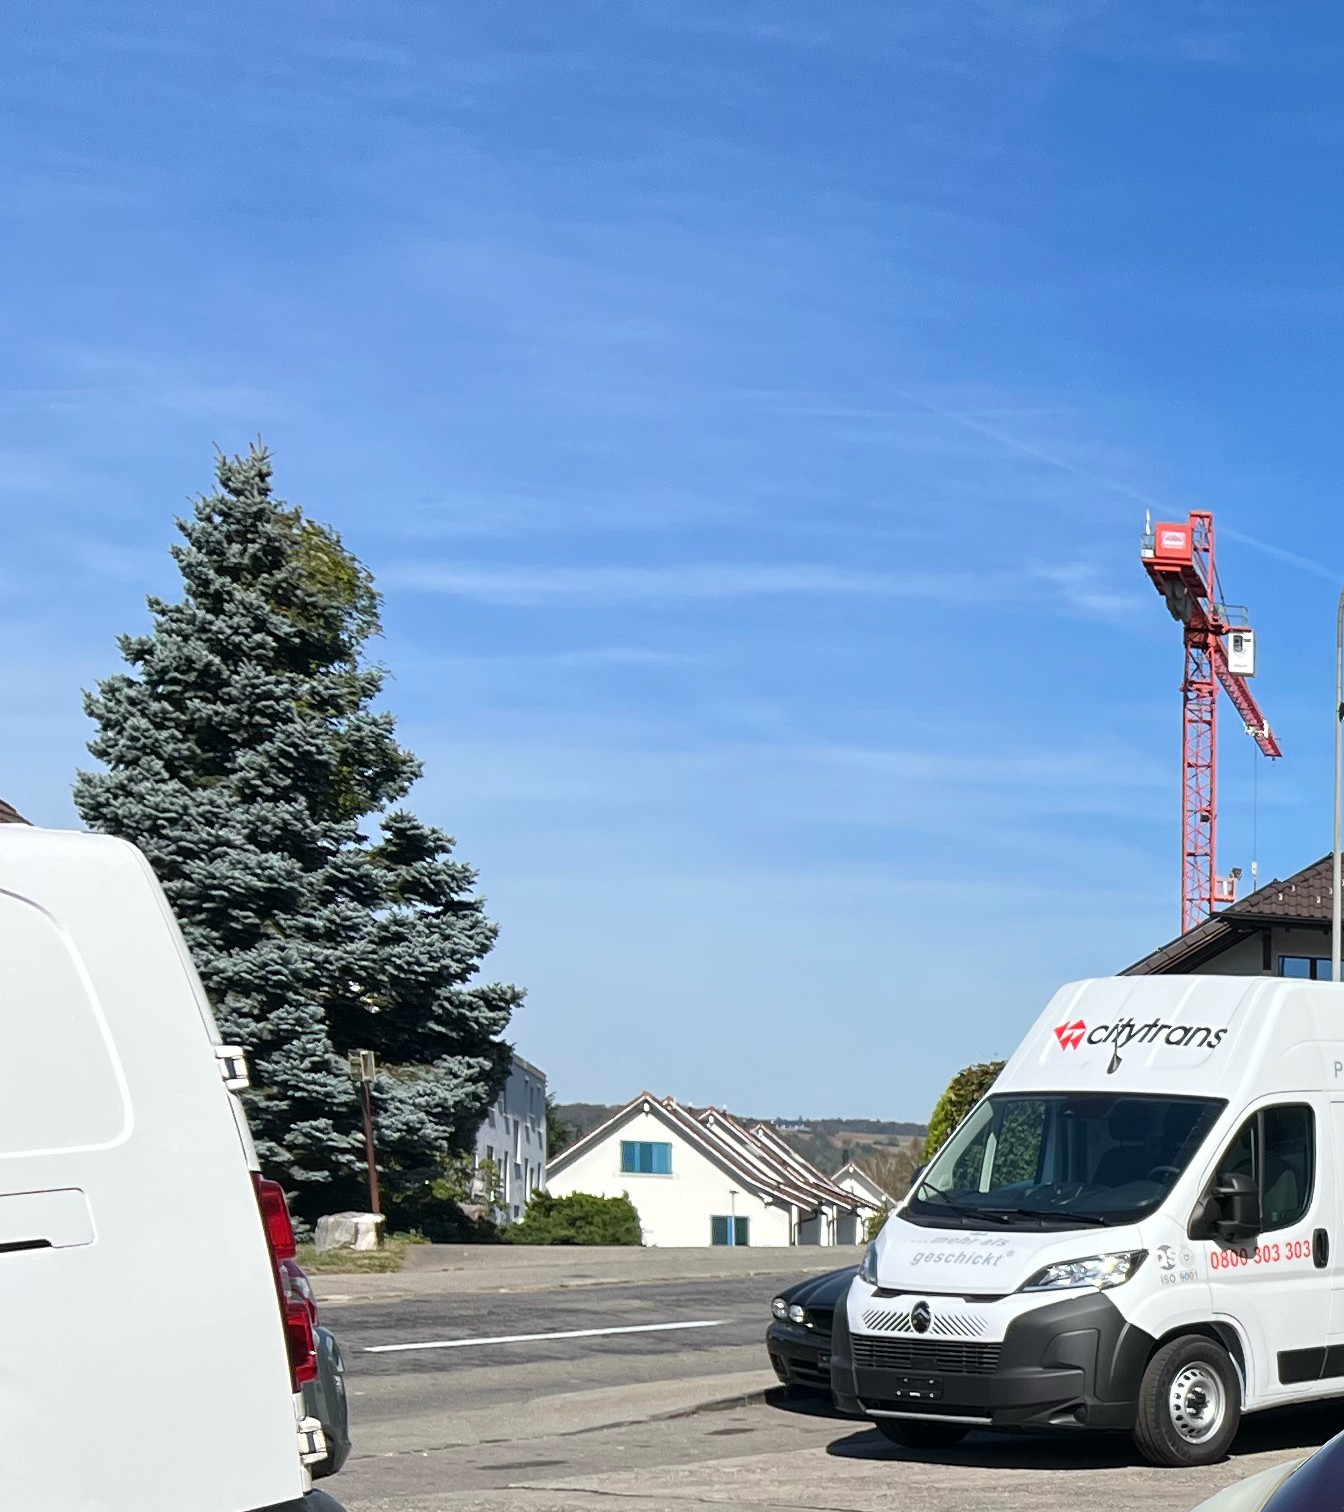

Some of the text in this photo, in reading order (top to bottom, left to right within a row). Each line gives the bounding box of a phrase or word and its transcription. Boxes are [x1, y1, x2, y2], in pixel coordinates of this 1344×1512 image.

[1087, 1017, 1228, 1049] citytrans
[1210, 1240, 1311, 1270] 0800 303 303
[1160, 1271, 1199, 1285] ISO 9001
